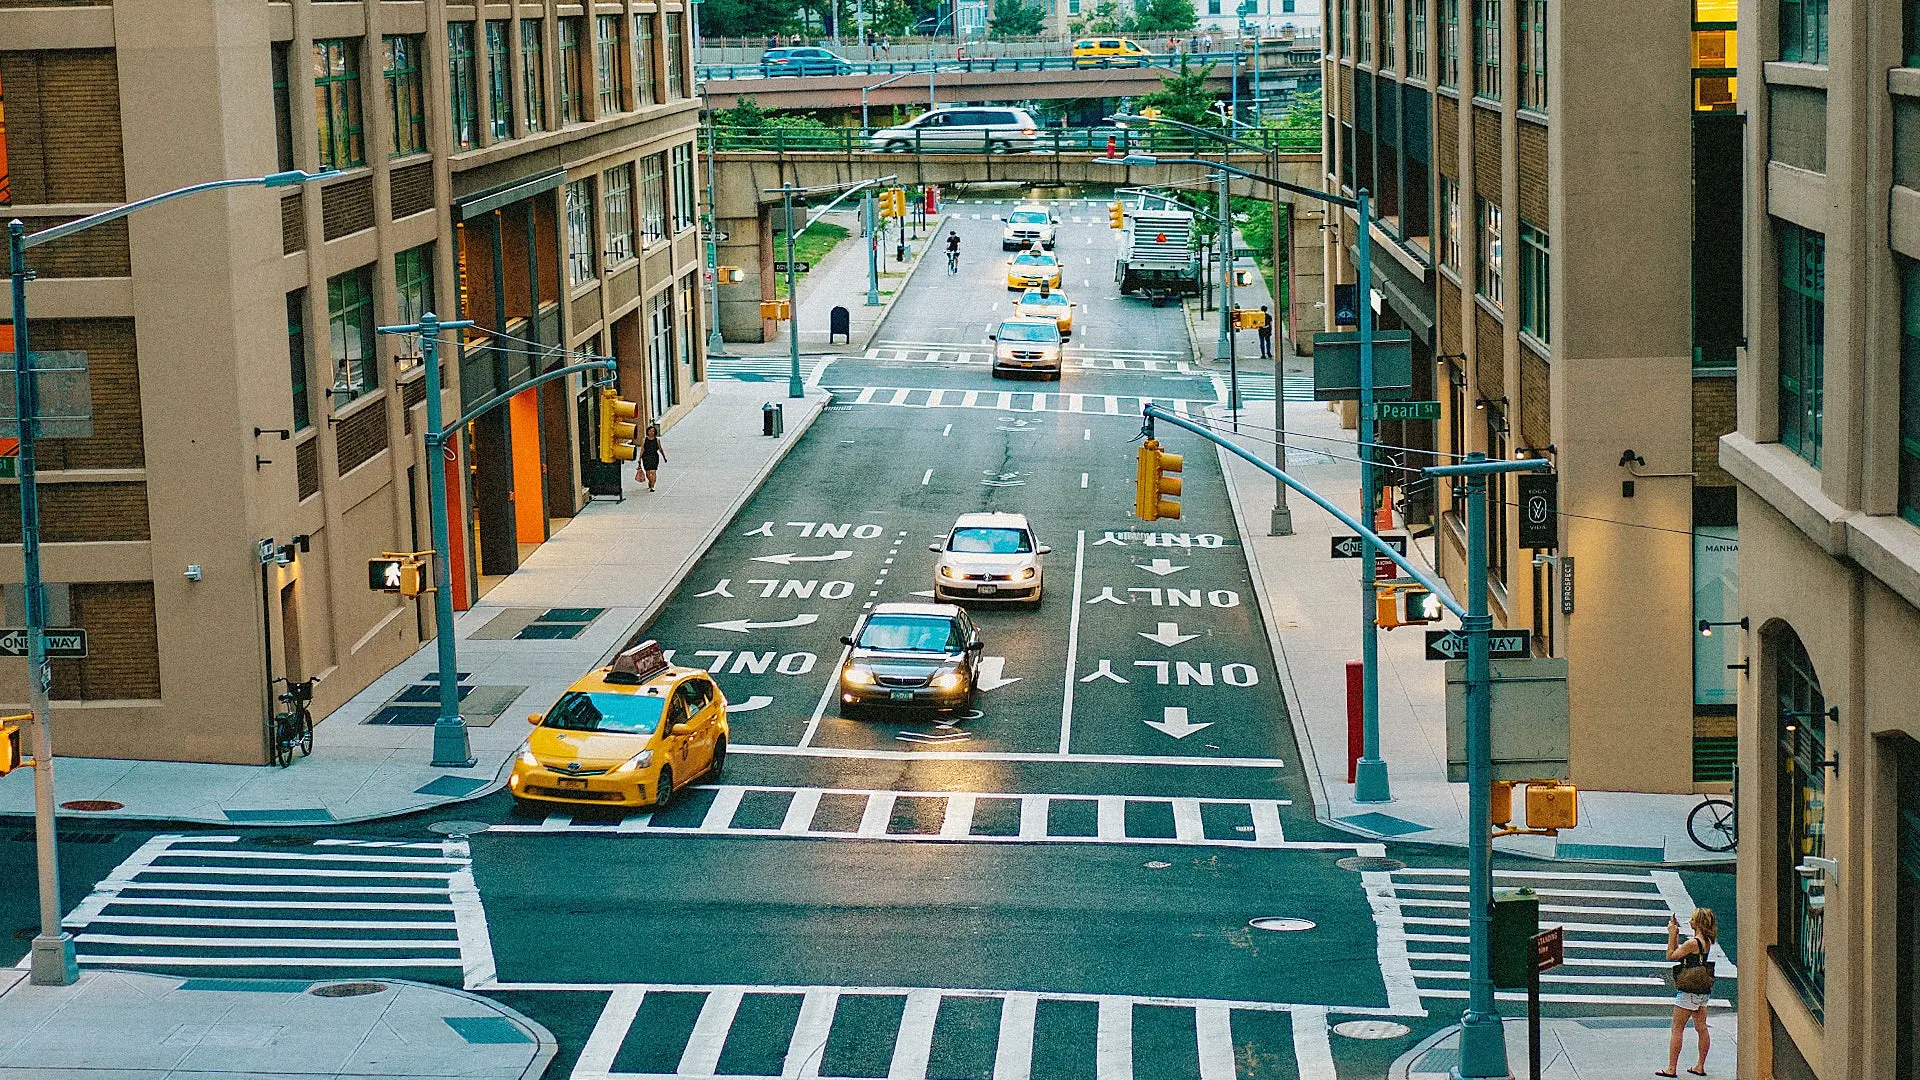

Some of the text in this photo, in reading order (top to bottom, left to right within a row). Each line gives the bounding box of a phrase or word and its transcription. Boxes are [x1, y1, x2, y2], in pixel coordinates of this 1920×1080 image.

[1383, 404, 1433, 418] Pearl St
[742, 521, 883, 539] ONLY
[1342, 542, 1363, 553] ONE
[1705, 544, 1738, 552] MANHA
[693, 579, 855, 600] ONLY
[1086, 586, 1240, 608] ONLY
[49, 637, 78, 648] WAY
[1079, 659, 1259, 687] ONLY
